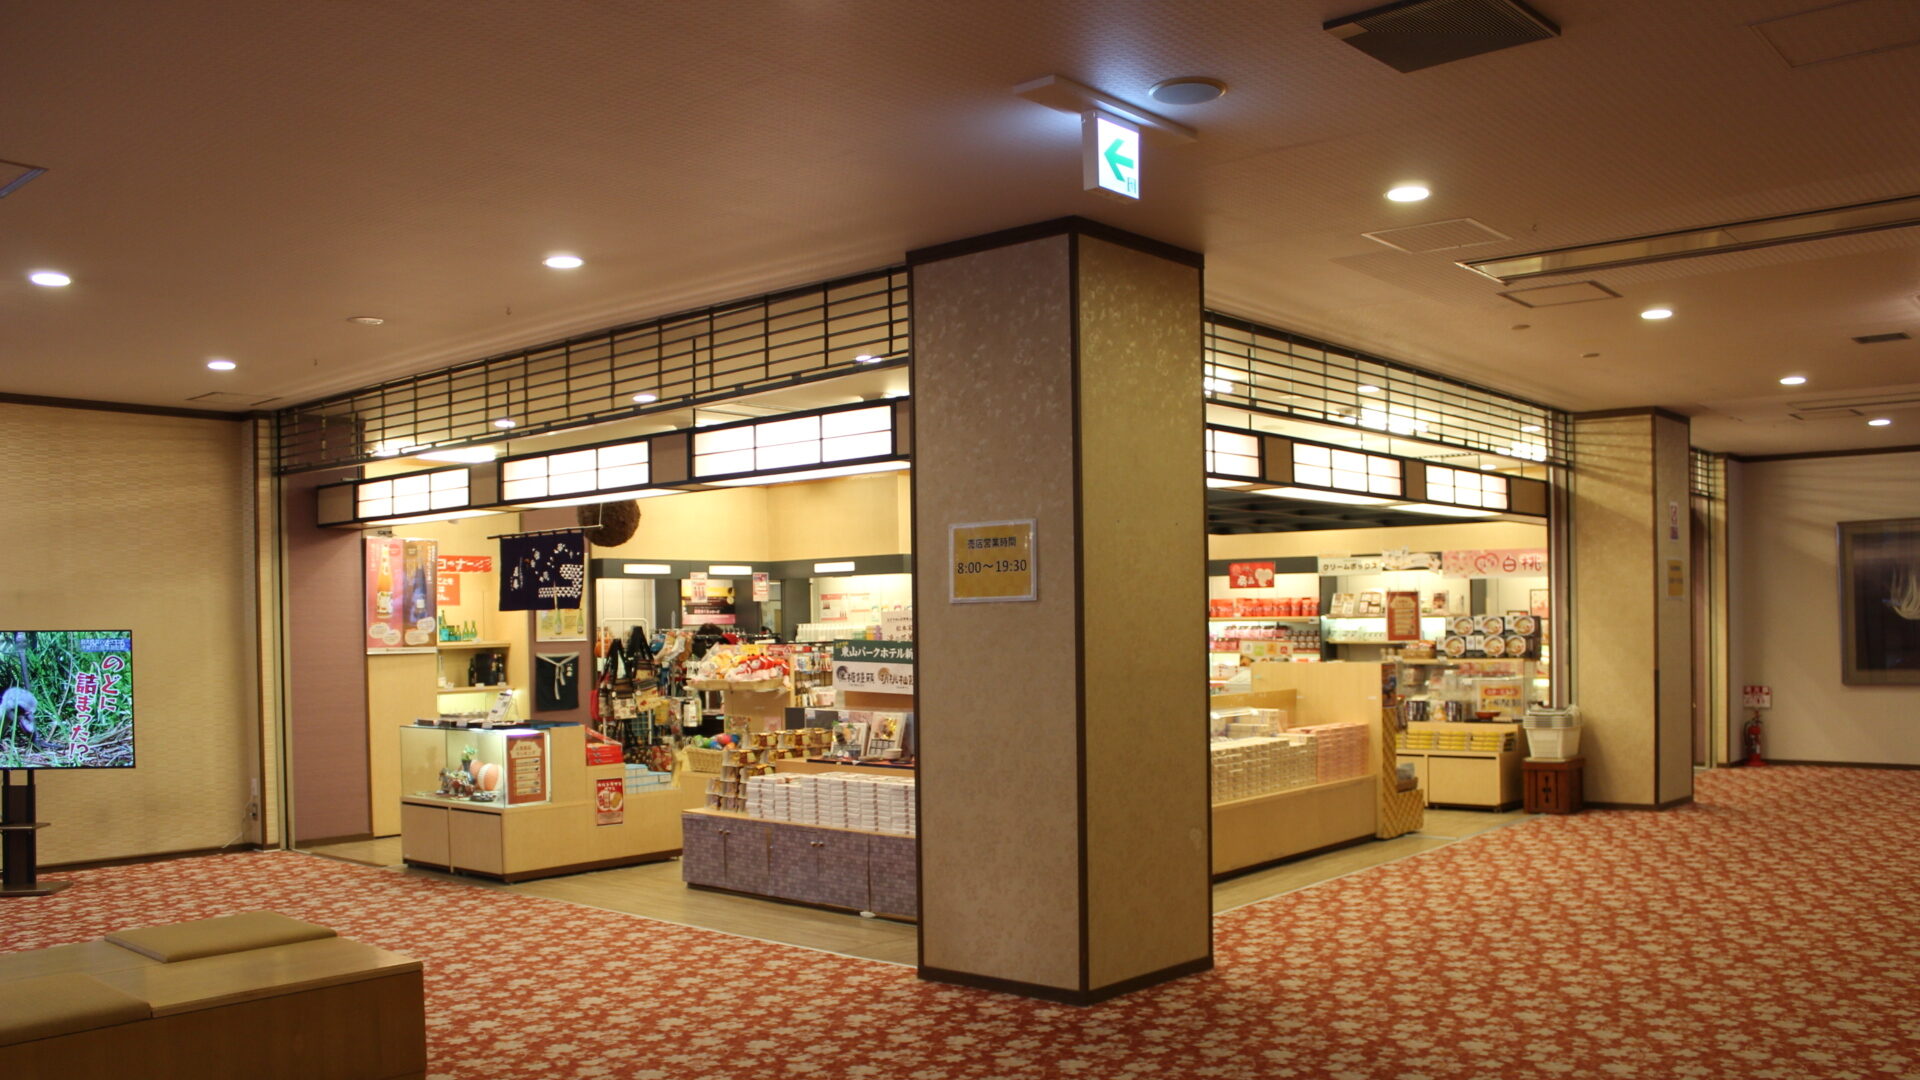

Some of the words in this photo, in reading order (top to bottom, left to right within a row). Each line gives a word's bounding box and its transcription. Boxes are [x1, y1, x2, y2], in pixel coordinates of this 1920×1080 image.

[967, 536, 1017, 549] 売店営業時間
[1503, 555, 1542, 573] 白桃
[101, 656, 124, 711] のどに
